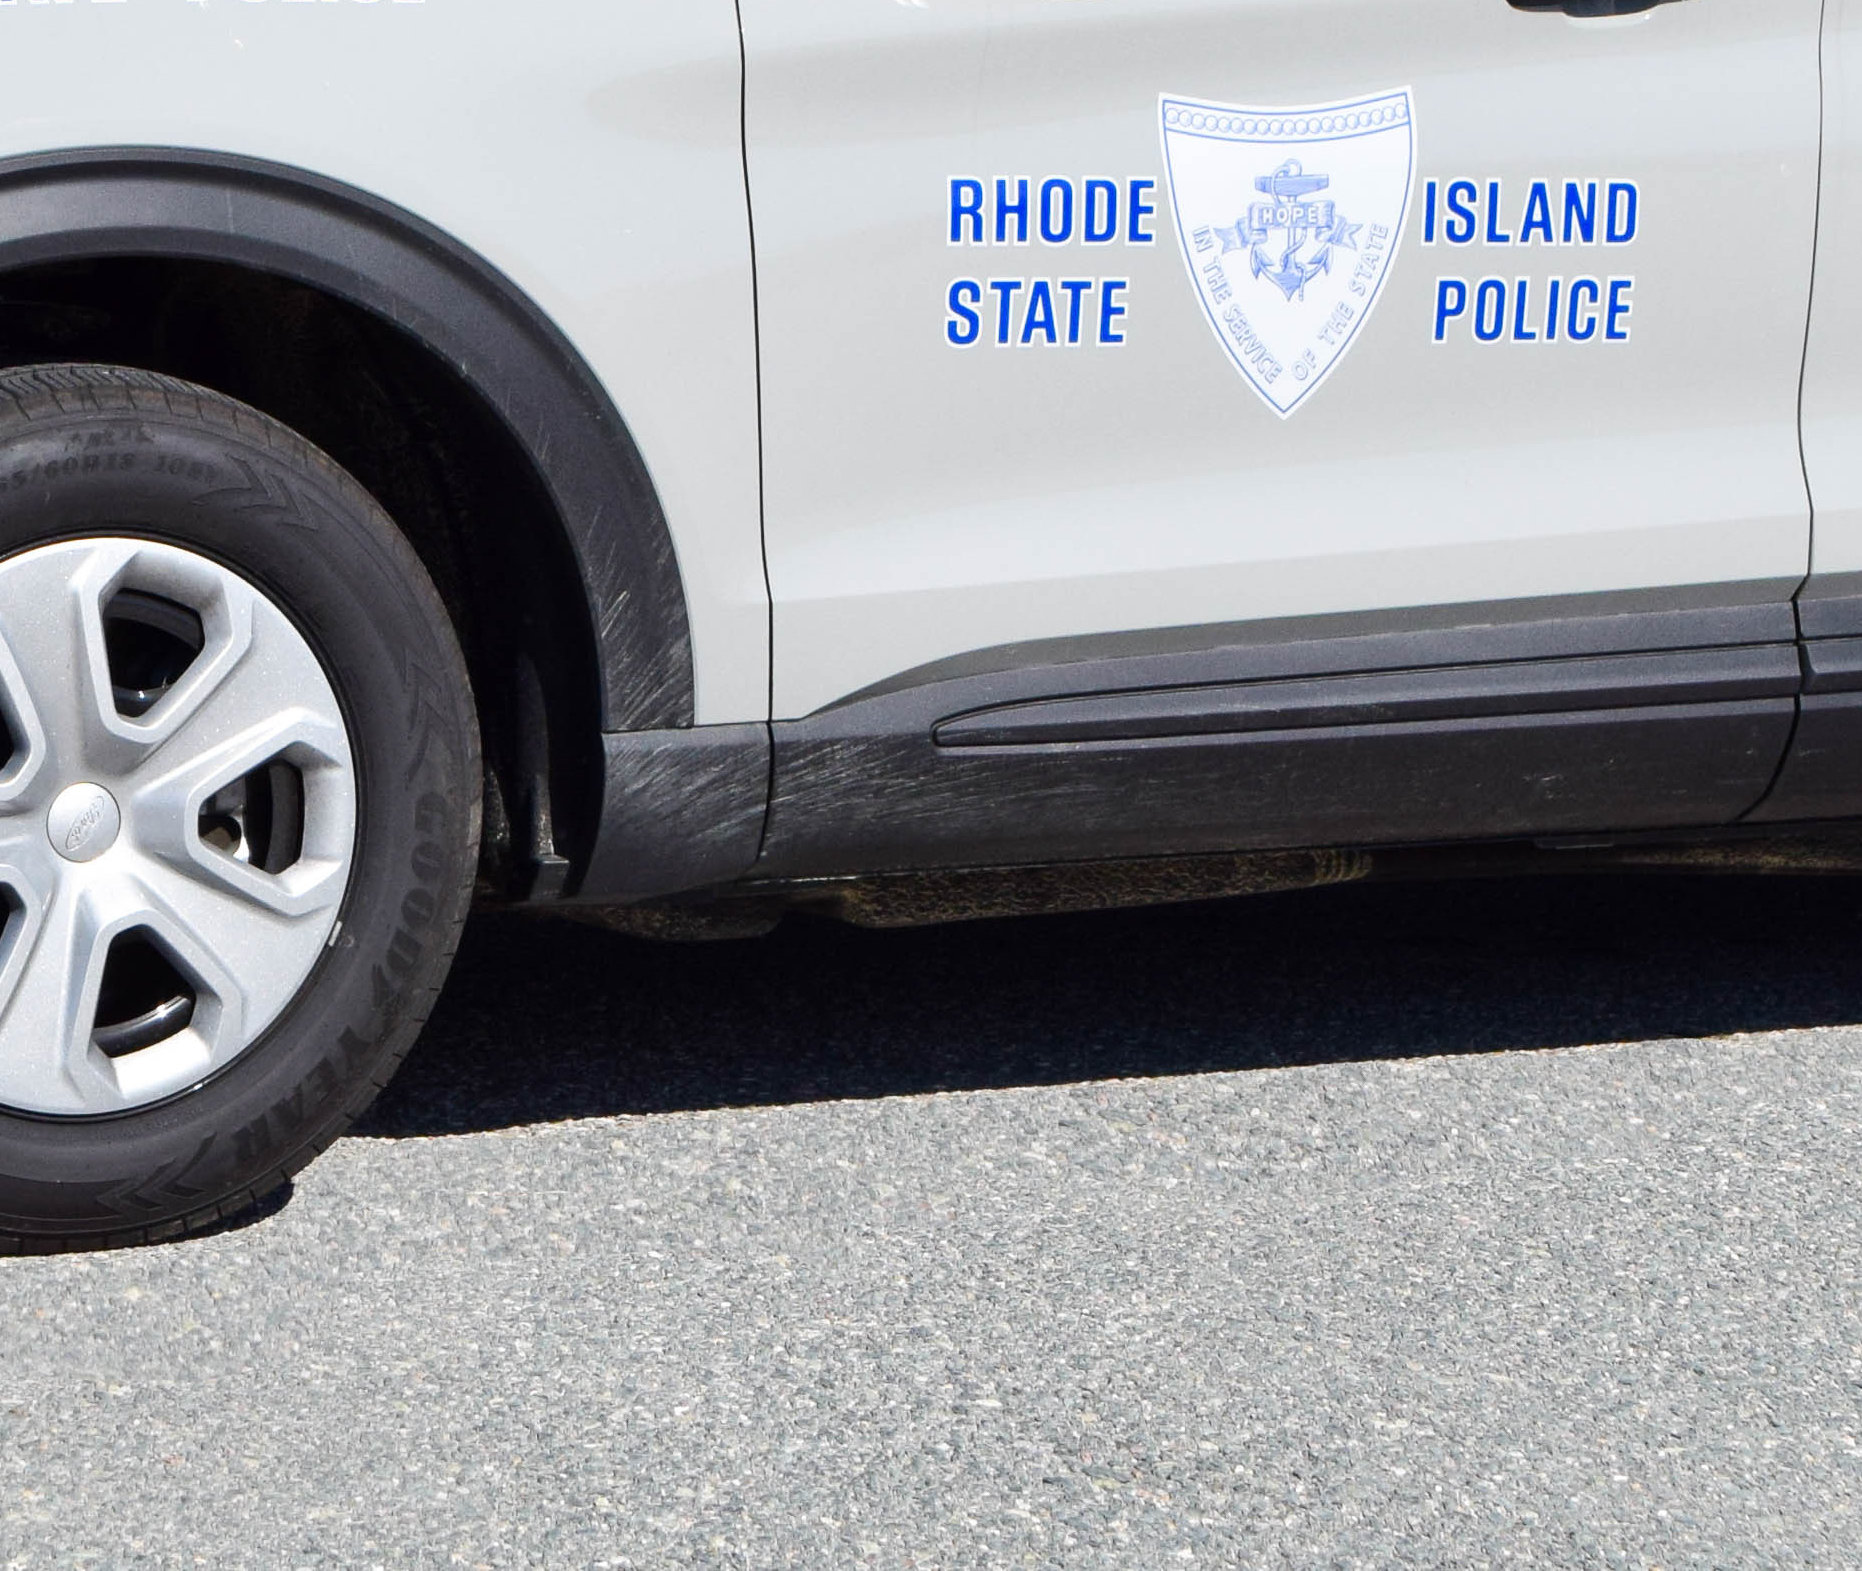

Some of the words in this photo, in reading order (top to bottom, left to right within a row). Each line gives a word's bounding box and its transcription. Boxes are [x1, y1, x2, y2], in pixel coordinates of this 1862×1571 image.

[949, 177, 1155, 244] RHODE
[1423, 179, 1638, 244] ISLAND
[1262, 206, 1320, 225] HOPE
[946, 279, 1128, 346] STATE
[1434, 278, 1633, 342] POLICE
[1192, 225, 1214, 253] IN
[1203, 256, 1233, 305] THE
[1223, 303, 1284, 385] SERVICE
[1291, 348, 1318, 381] OF
[1317, 301, 1355, 346] THE
[1349, 223, 1389, 297] STATE
